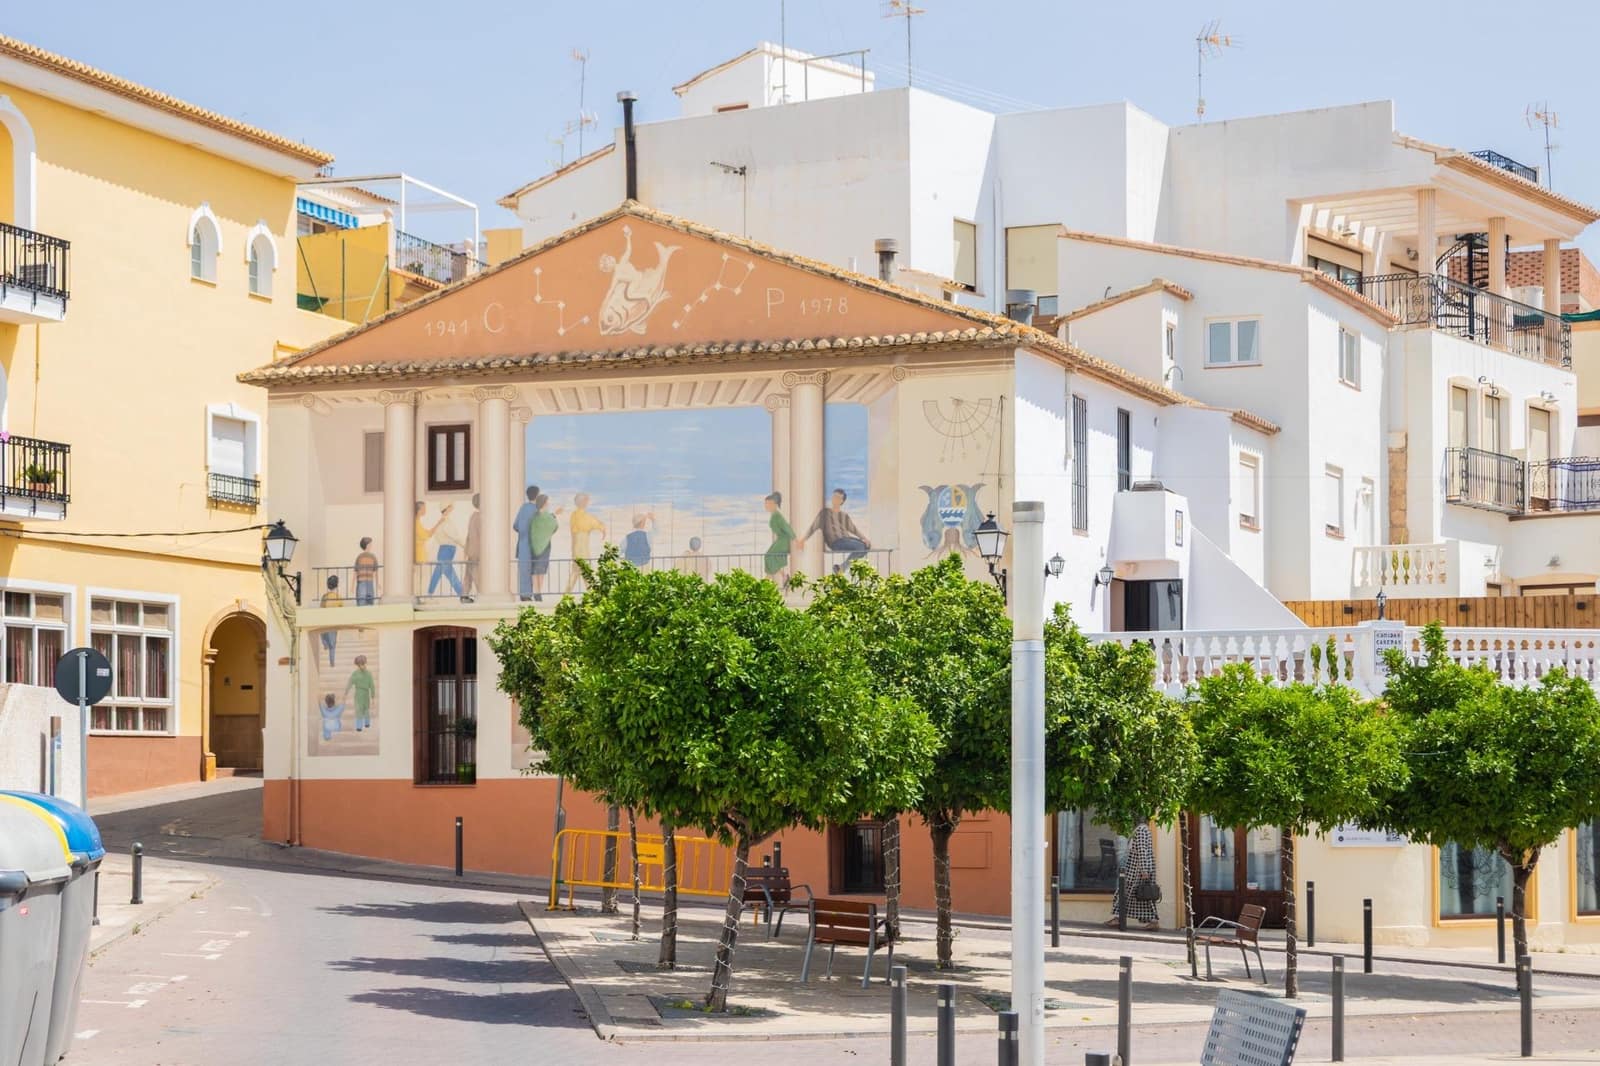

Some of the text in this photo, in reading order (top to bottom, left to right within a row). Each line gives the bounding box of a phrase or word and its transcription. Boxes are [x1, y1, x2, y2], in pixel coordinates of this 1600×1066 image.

[766, 287, 848, 318] P 1978
[424, 302, 505, 336] 1941 C
